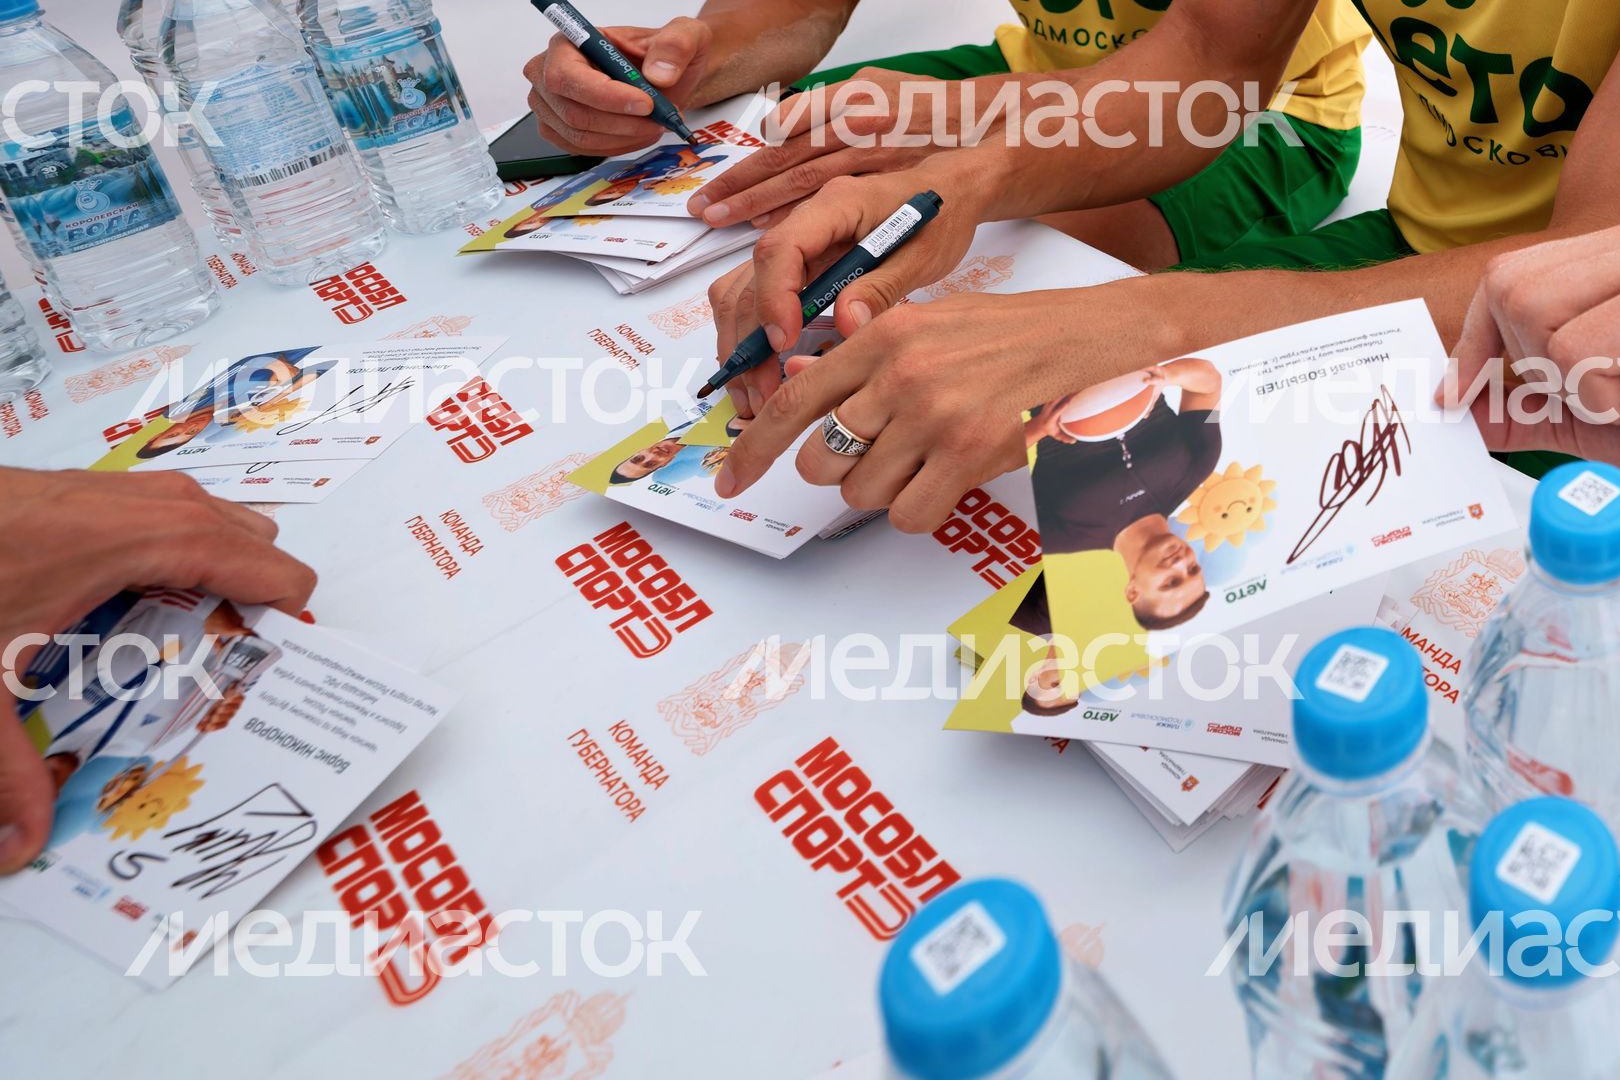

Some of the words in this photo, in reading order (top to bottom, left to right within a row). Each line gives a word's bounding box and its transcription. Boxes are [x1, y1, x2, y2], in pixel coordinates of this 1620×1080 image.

[598, 39, 633, 75] berlingo
[65, 207, 146, 245] ВОДА
[343, 260, 408, 311] ОСОБЛ
[814, 267, 864, 308] berlingo
[586, 328, 641, 371] ГУБЕРНАТОРА
[615, 322, 656, 357] КОМАНДА
[1328, 352, 1390, 374] Николай
[1253, 367, 1327, 395] БОБЫЛЕВ
[454, 375, 535, 446] ОСОБЛ
[404, 515, 462, 580] ГУБЕРНАТОРА
[439, 508, 484, 558] КОМАНДА
[555, 543, 660, 647] СПОРТ
[593, 521, 713, 634] МОСОБЛ
[243, 717, 315, 758] НИКОНОРОВ
[608, 720, 671, 791] КОМАНДА
[567, 729, 647, 823] ГУБЕРНАТОРА
[754, 769, 888, 900] СПОРТ
[794, 736, 962, 905] МОСОБЛ
[315, 823, 426, 962] СПОРТ
[369, 789, 501, 966] МОСОБЛ
